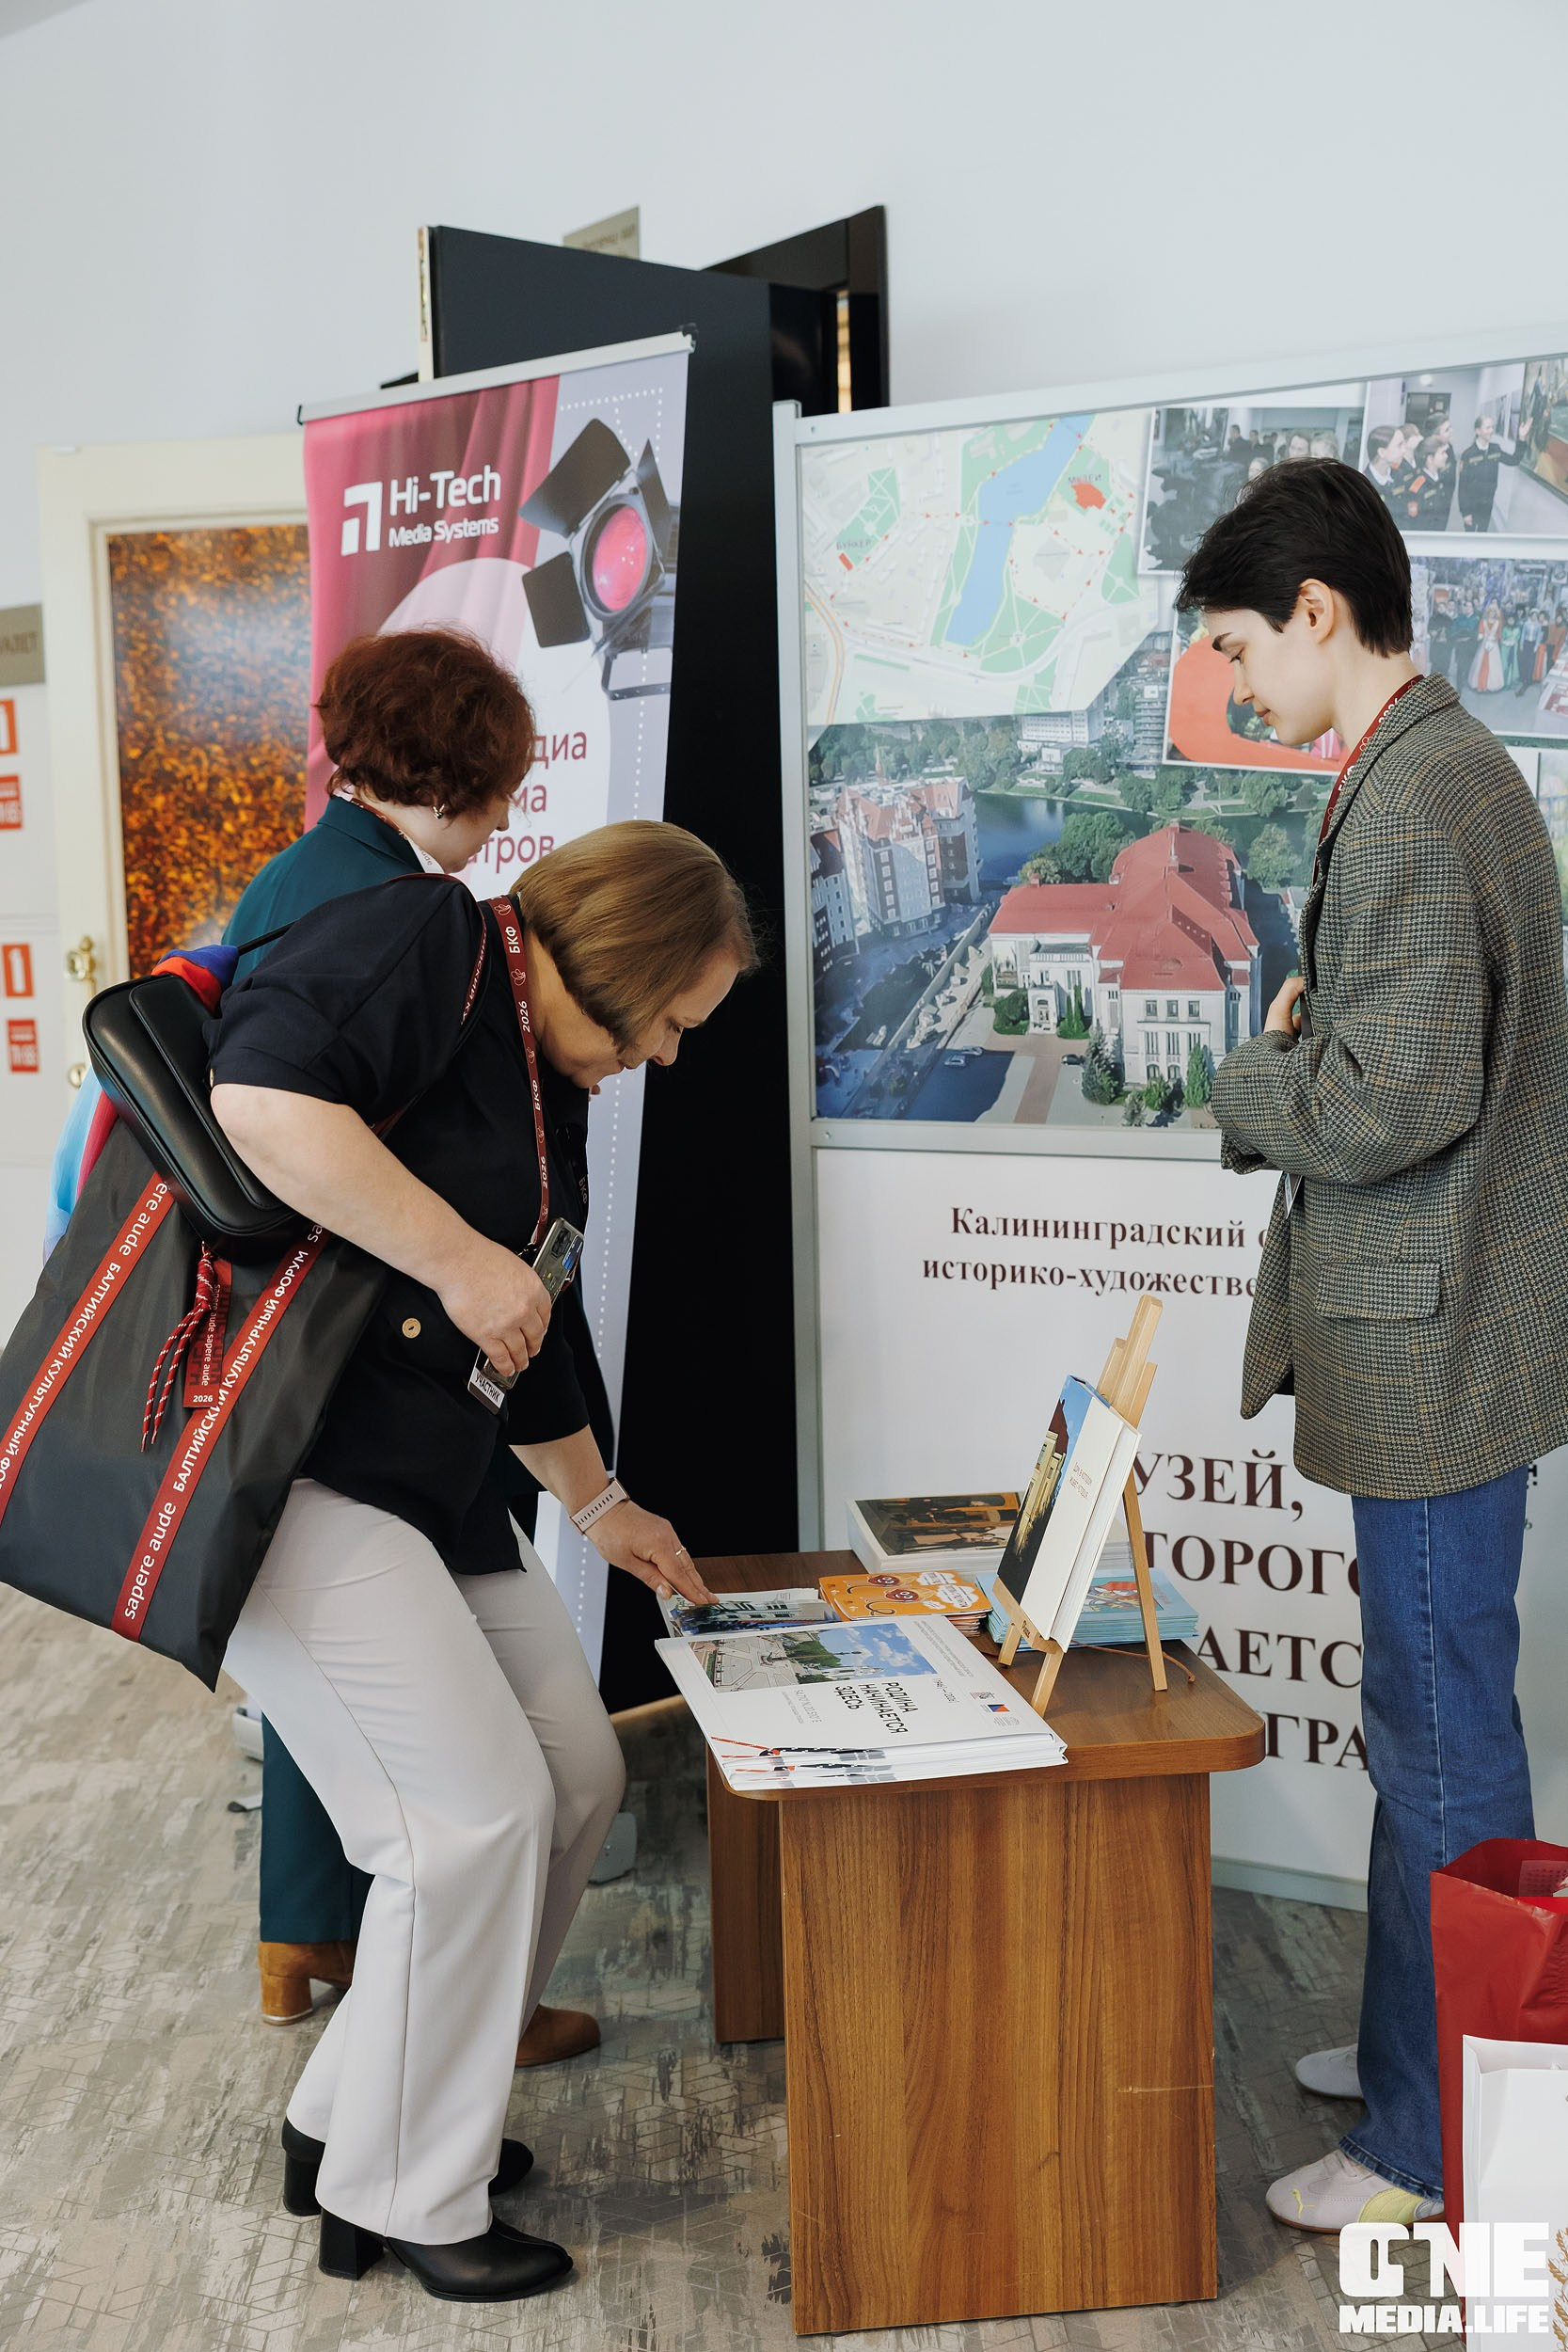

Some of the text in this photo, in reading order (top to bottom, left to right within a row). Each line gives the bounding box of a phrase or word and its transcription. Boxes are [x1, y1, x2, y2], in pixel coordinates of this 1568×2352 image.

[390, 465, 501, 516] Hi-Tech
[388, 516, 499, 548] Media Systems
[528, 731, 587, 770] диа
[510, 785, 547, 813] ма
[504, 926, 521, 954] БКФ
[518, 1000, 531, 1033] 2026
[532, 1080, 541, 1111] БКФ
[540, 1155, 548, 1189] 2026
[119, 1183, 168, 1256] ere aude
[950, 1206, 1246, 1249] Калининградский
[923, 1258, 1258, 1296] историко-художестве
[222, 1298, 280, 1388] КУЛЬТУРНЫЙ
[274, 1250, 309, 1298] ФОРУМ
[204, 1333, 214, 1362] sapere
[0, 1262, 121, 1489] БАЛТИЙСКИЙ КУЛЬТУРНЫЙ ФО
[201, 1362, 211, 1386] aude
[475, 1372, 501, 1403] УЧАСТНИК
[192, 1394, 214, 1403] 2026
[1133, 1449, 1304, 1522] УЗЕЙ,
[124, 1502, 177, 1620] sapere aude
[1143, 1531, 1362, 1598] ТОРОГ
[1197, 1626, 1363, 1690] АЕТС
[833, 1685, 865, 1710] ЗДЕСЬ
[858, 1683, 909, 1734] НАЧИНАЕТСЯ
[881, 1682, 919, 1713] РОДИНА
[1259, 1711, 1370, 1772] ГРА
